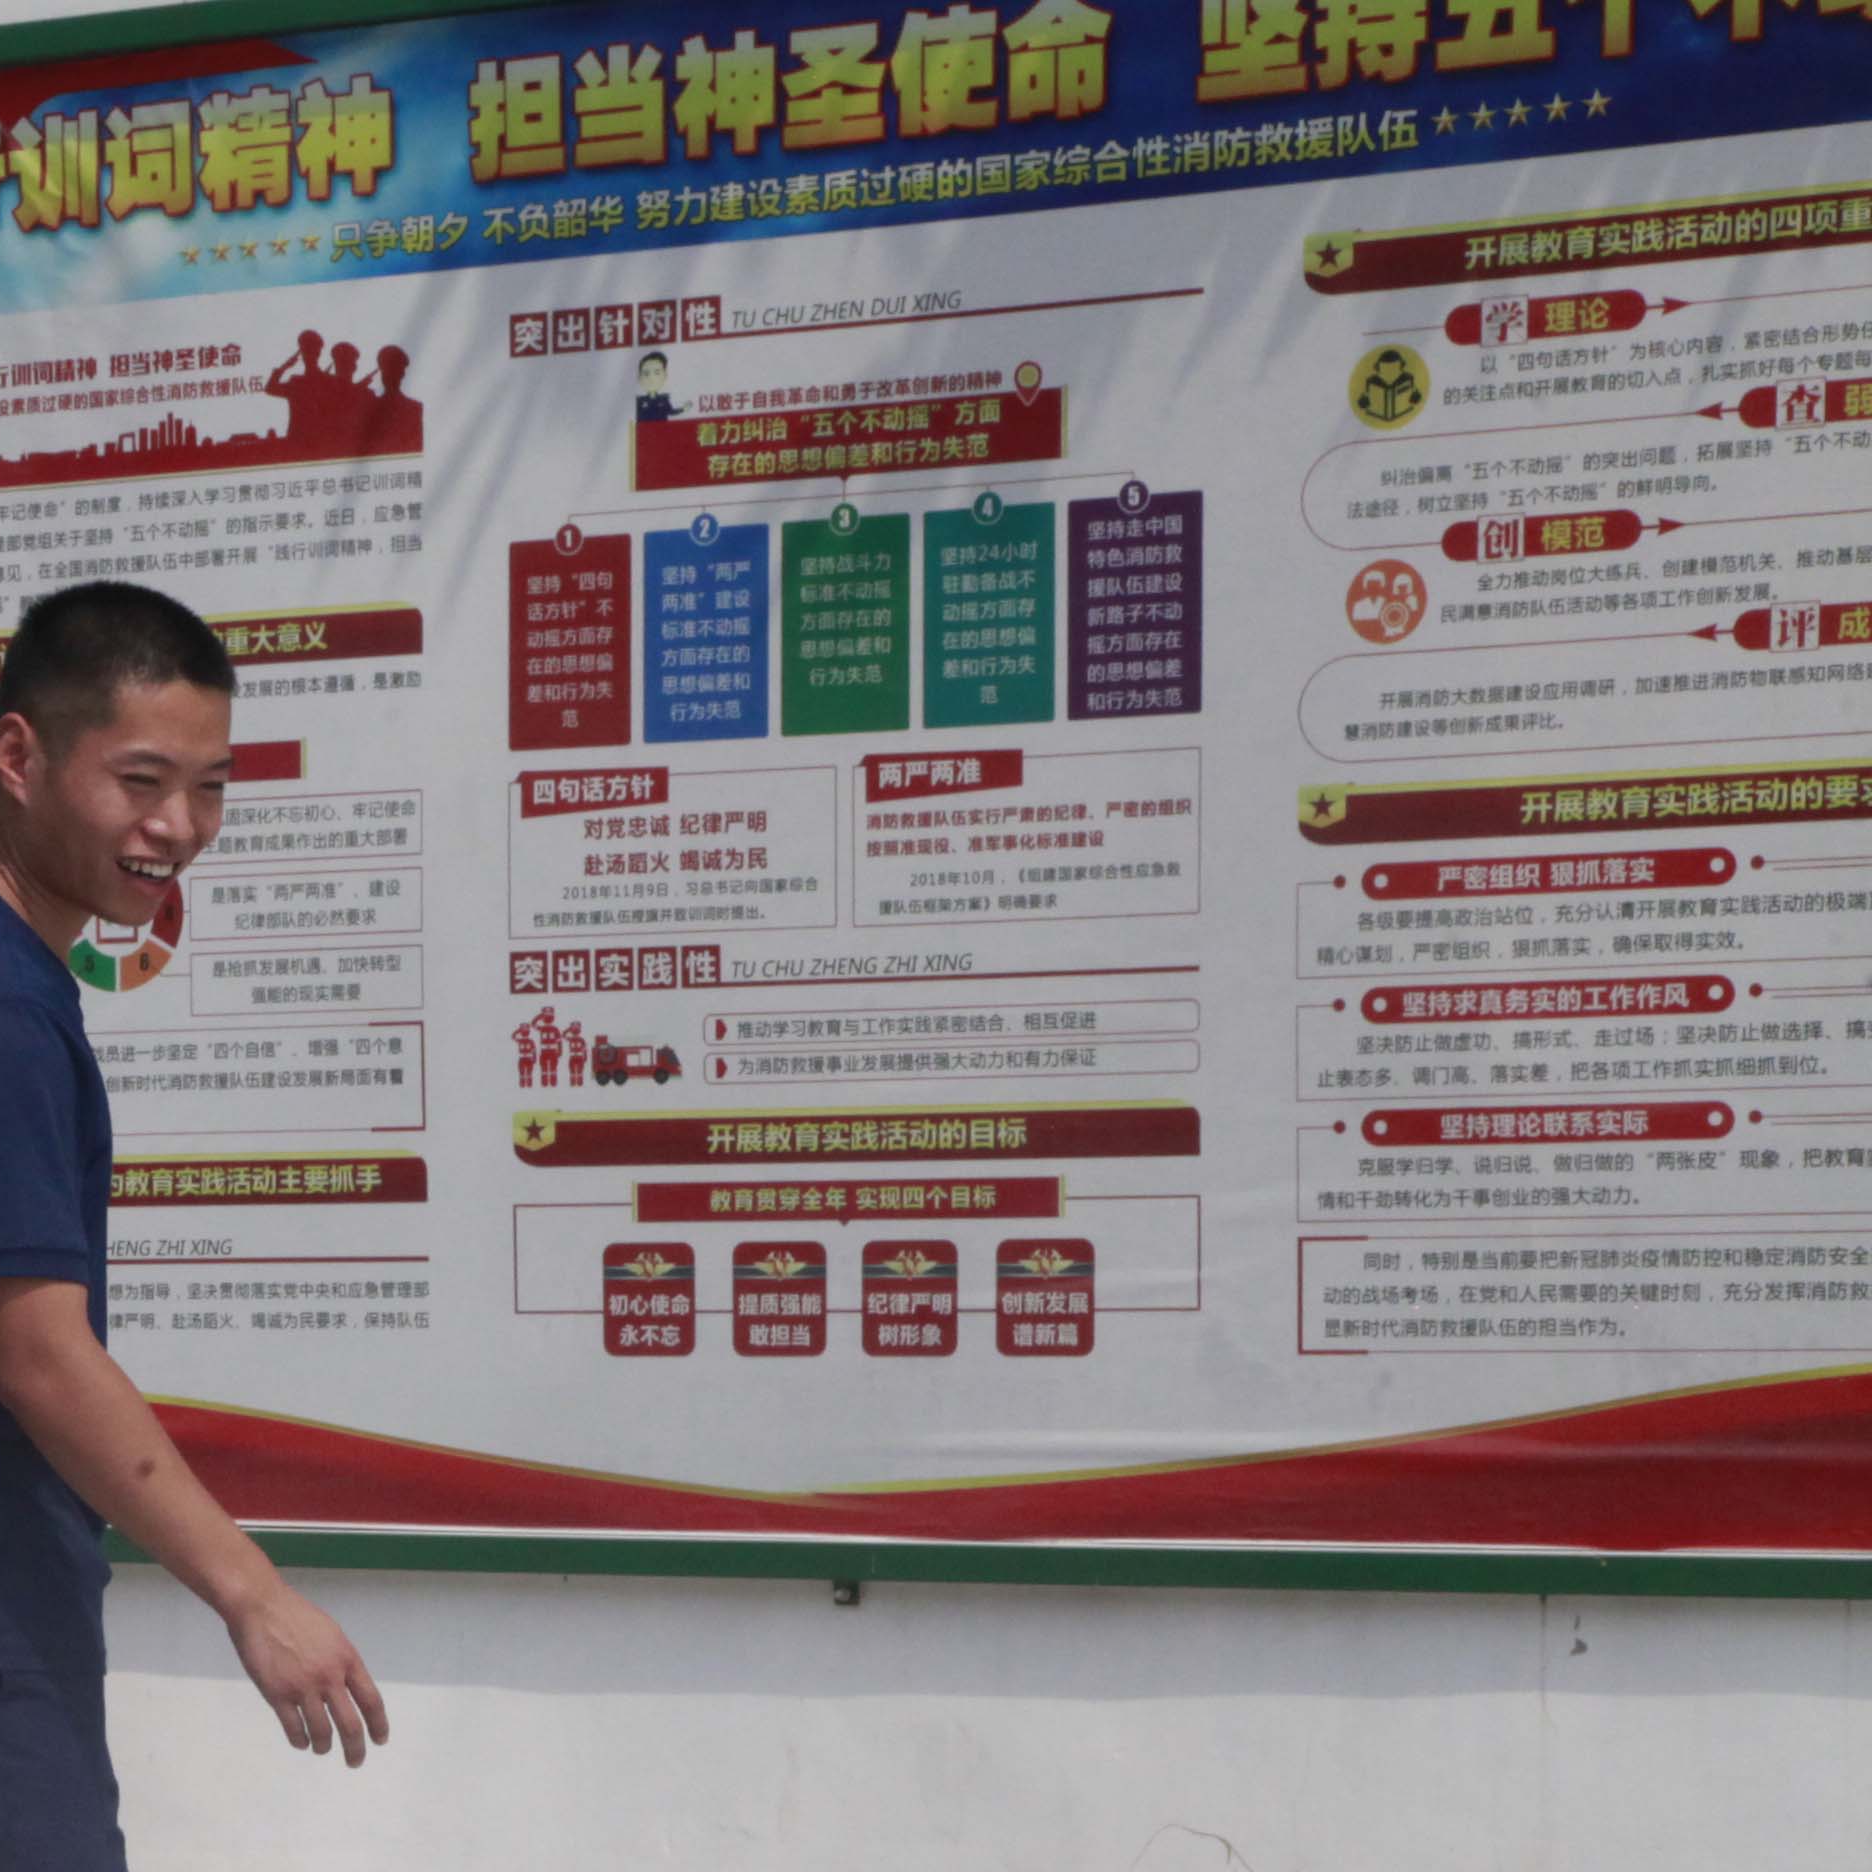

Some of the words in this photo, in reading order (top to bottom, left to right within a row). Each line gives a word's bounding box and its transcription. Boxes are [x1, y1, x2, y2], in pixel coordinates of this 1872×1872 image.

[468, 0, 1113, 184] 担当神圣使命
[329, 214, 467, 263] 只争朝夕
[482, 193, 624, 246] 不负韶华
[636, 109, 1419, 231] 努力建设素质过硬的国家综合性消防救援队伍
[732, 310, 756, 329] TU
[761, 306, 805, 327] CHU
[810, 300, 864, 323] ZHEN
[870, 296, 906, 318] DUI
[912, 290, 962, 313] XING
[1484, 300, 1525, 343] 学
[1545, 297, 1610, 333] 理论
[512, 298, 720, 355] 突出针对性
[109, 343, 242, 378] 担当神圣使命
[698, 369, 1002, 413] 以敢于自我革命和勇于改革创新的精神
[707, 433, 990, 478] 存在的思想偏差和行为失范
[981, 498, 995, 518] 4
[1126, 485, 1139, 506] 5
[699, 518, 711, 538] 2
[838, 508, 851, 529] 3
[1087, 514, 1184, 541] 坚持走中国
[564, 529, 574, 549] 1
[1482, 519, 1522, 560] 创
[1541, 516, 1605, 551] 模范
[800, 551, 892, 576] 坚持战斗力
[941, 540, 1038, 568] 坚持24小时
[1087, 543, 1184, 568] 特色消防救
[800, 579, 892, 603] 标准不动摇
[941, 569, 1036, 594] 驻勤备战不
[1087, 571, 1184, 597] 援队伍建设
[800, 606, 892, 631] 方面存在的
[941, 598, 1036, 623] 动摇方面存
[1087, 600, 1184, 626] 新路子不动
[527, 625, 613, 650] 动摇方面存
[662, 615, 751, 640] 标准不动摇
[941, 626, 1036, 650] 在的思想偏
[800, 635, 892, 659] 思想偏差和
[1087, 629, 1184, 654] 摇方面存在
[527, 652, 613, 677] 在的思想偏
[662, 643, 751, 668] 方面存在的
[941, 653, 1036, 678] 差和行为失
[662, 671, 751, 695] 思想偏差和
[809, 661, 883, 686] 行为失范
[1087, 658, 1184, 683] 的思想偏差
[527, 680, 613, 704] 差和行为失
[980, 684, 999, 705] 范
[1380, 661, 1872, 711] 开展消防大数据建设应用调研，加速推进消防物联感知网络
[1087, 686, 1183, 712] 和行为失范
[562, 709, 579, 729] 范
[669, 700, 742, 724] 行为失范
[878, 759, 983, 788] 两严两准
[533, 775, 655, 805] 四句话方针
[222, 799, 416, 827] 固深化不忘初心、牢记使命
[584, 815, 670, 840] 对党忠诚
[680, 810, 768, 836] 纪律严明
[205, 827, 408, 854] 题教育成果作出的重大部署
[584, 851, 670, 877] 赴汤蹈火
[680, 847, 768, 873] 竭诚为民
[1438, 863, 1539, 893] 严密组织
[1551, 857, 1655, 887] 狠抓落实
[234, 907, 378, 931] 纪律部队的必然要求
[1357, 890, 1872, 932] 各级要提高政治站位，充分认清开展教育实践活动的极端
[512, 946, 720, 991] 突出实践性
[732, 962, 756, 979] TU
[761, 959, 805, 978] CHU
[810, 957, 880, 977] ZHENG
[885, 955, 918, 974] ZHI
[923, 953, 973, 973] XING
[1402, 983, 1690, 1018] 坚持求真务实的工作作风
[736, 1048, 1097, 1077] 为消防救援事业发展提供强大动力和有力保证
[707, 1118, 1027, 1154] 开展教育实践活动的目标
[1440, 1109, 1649, 1139] 坚持理论联系实际
[710, 1188, 846, 1213] 教育贯穿全年
[856, 1186, 997, 1211] 实现四个目标
[107, 1240, 151, 1258] HENG
[156, 1240, 186, 1256] ZHI
[190, 1239, 233, 1256] XING
[608, 1294, 690, 1318] 初心使命
[738, 1294, 821, 1317] 提质强能
[868, 1293, 953, 1316] 纪律严明
[1001, 1292, 1089, 1316] 创新发展
[619, 1325, 681, 1348] 永不忘
[749, 1324, 810, 1348] 敢担当
[878, 1324, 943, 1348] 树形象
[1012, 1323, 1079, 1347] 谱新篇
